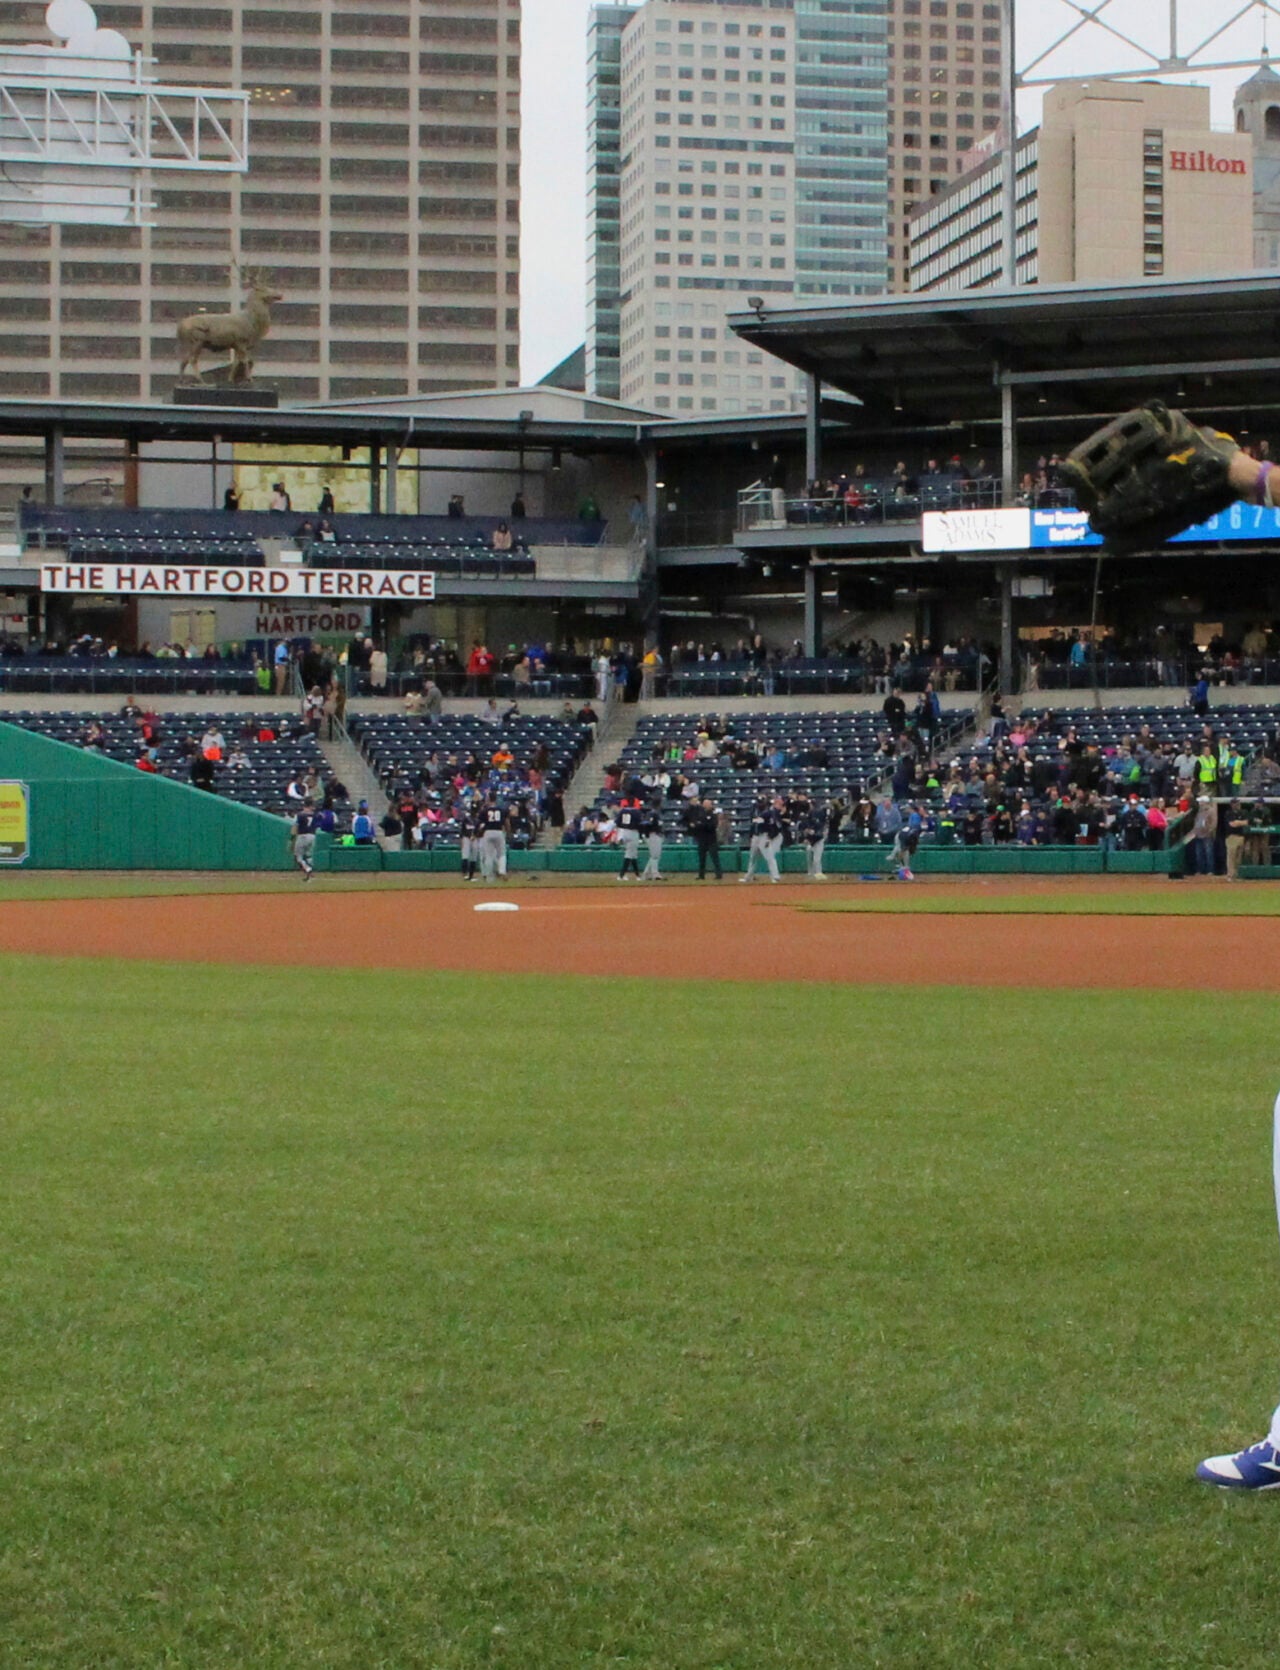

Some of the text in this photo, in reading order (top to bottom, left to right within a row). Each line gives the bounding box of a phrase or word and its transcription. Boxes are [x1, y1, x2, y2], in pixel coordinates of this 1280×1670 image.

[1170, 150, 1246, 174] Hilton
[1230, 503, 1242, 529] 6
[1253, 505, 1264, 528] 7
[44, 566, 432, 597] THE HARTFORD TERRACE
[256, 613, 362, 633] HARTFORD
